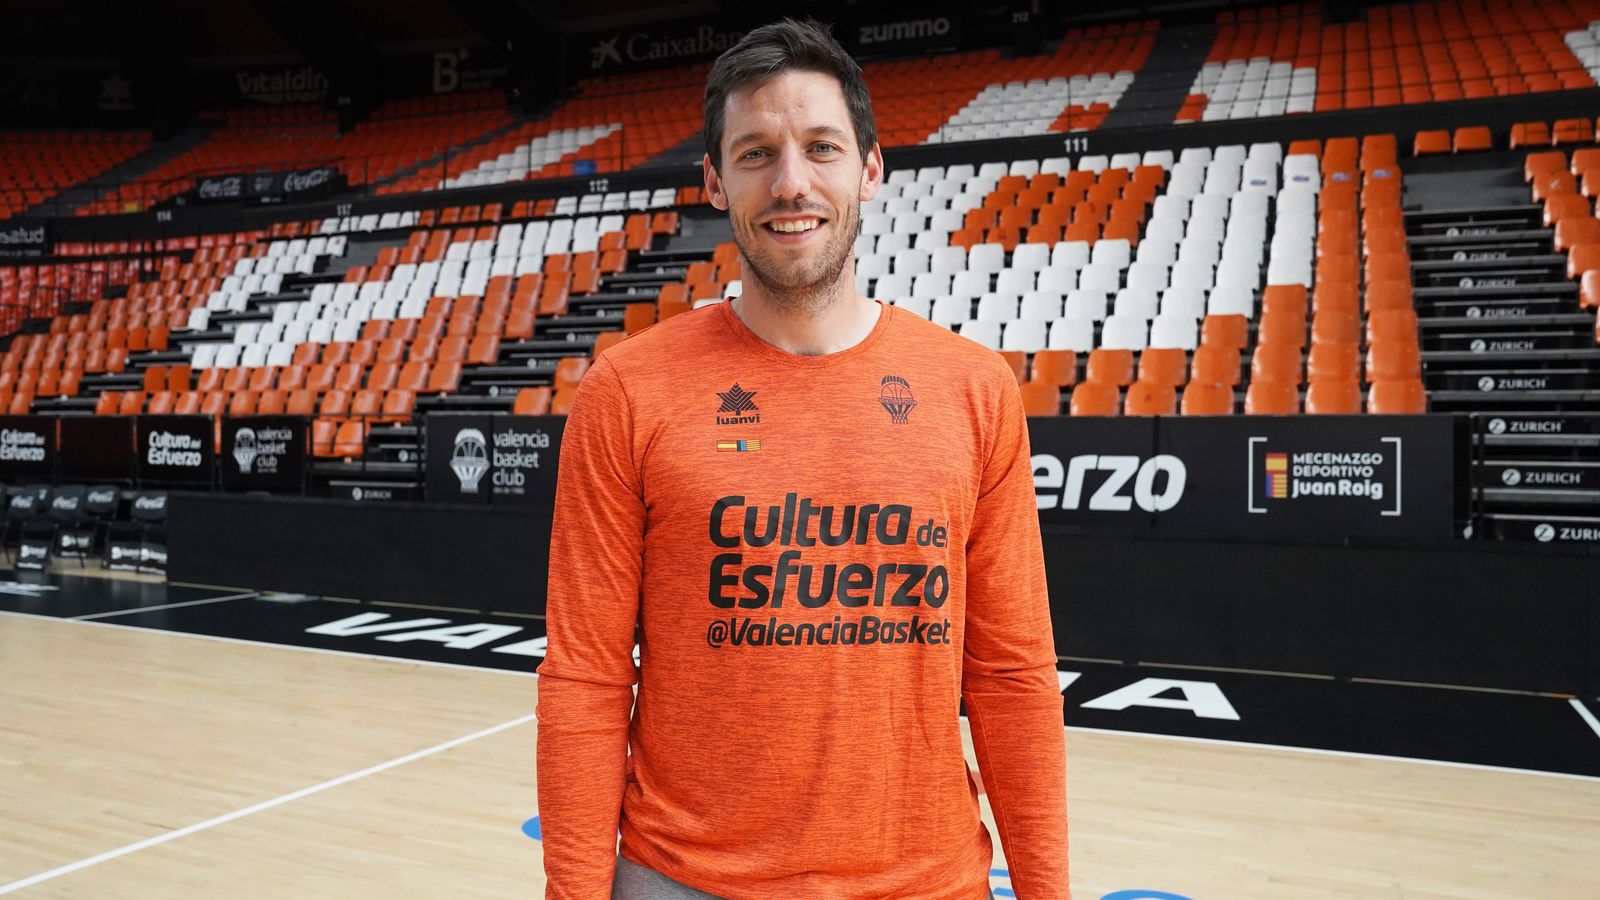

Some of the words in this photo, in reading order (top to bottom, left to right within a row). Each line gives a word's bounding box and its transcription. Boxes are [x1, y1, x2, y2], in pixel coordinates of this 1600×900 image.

[859, 17, 949, 44] zummo
[236, 66, 329, 92] Vitaldin
[1064, 138, 1088, 153] 111
[1490, 341, 1534, 352] ZURICH
[1498, 378, 1546, 389] ZURICH
[716, 413, 760, 425] luanvi
[1510, 421, 1562, 432] ZURICH
[149, 430, 191, 450] Cultura
[257, 427, 293, 441] valencia
[493, 430, 550, 449] valencia
[147, 448, 201, 467] Esfuerzo
[257, 456, 278, 468] club
[493, 450, 540, 469] basket
[1292, 453, 1384, 465] MECENAZGO
[492, 470, 526, 487] club
[1292, 466, 1374, 478] DEPORTIVO
[1525, 472, 1582, 484] ZURICH
[1291, 478, 1337, 499] Juan
[1338, 479, 1384, 500] Roig
[708, 492, 913, 549] Cultura
[1560, 527, 1600, 541] ZURI
[708, 549, 950, 609] Esfuerzo
[706, 615, 951, 649] @ValenciaBasket
